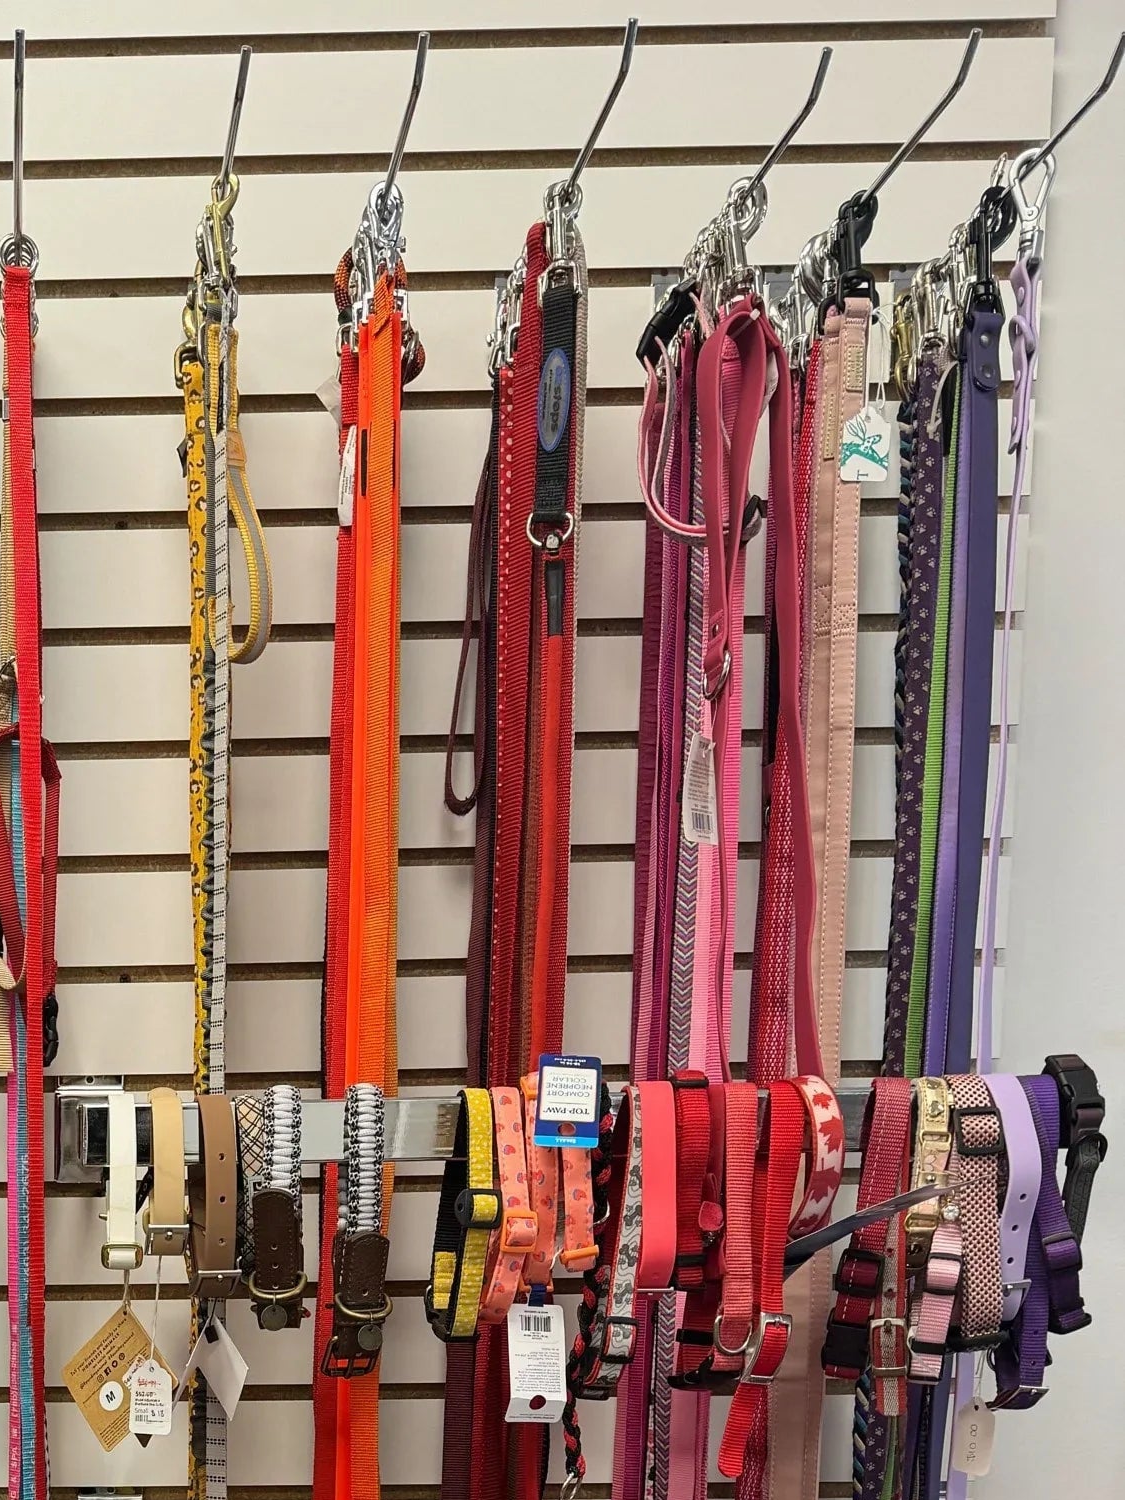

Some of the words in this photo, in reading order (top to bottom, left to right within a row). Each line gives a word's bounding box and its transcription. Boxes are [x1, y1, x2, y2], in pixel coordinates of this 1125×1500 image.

[546, 1082, 593, 1090] NEOPRENE
[546, 1090, 590, 1098] COMFORT
[105, 1390, 115, 1404] M
